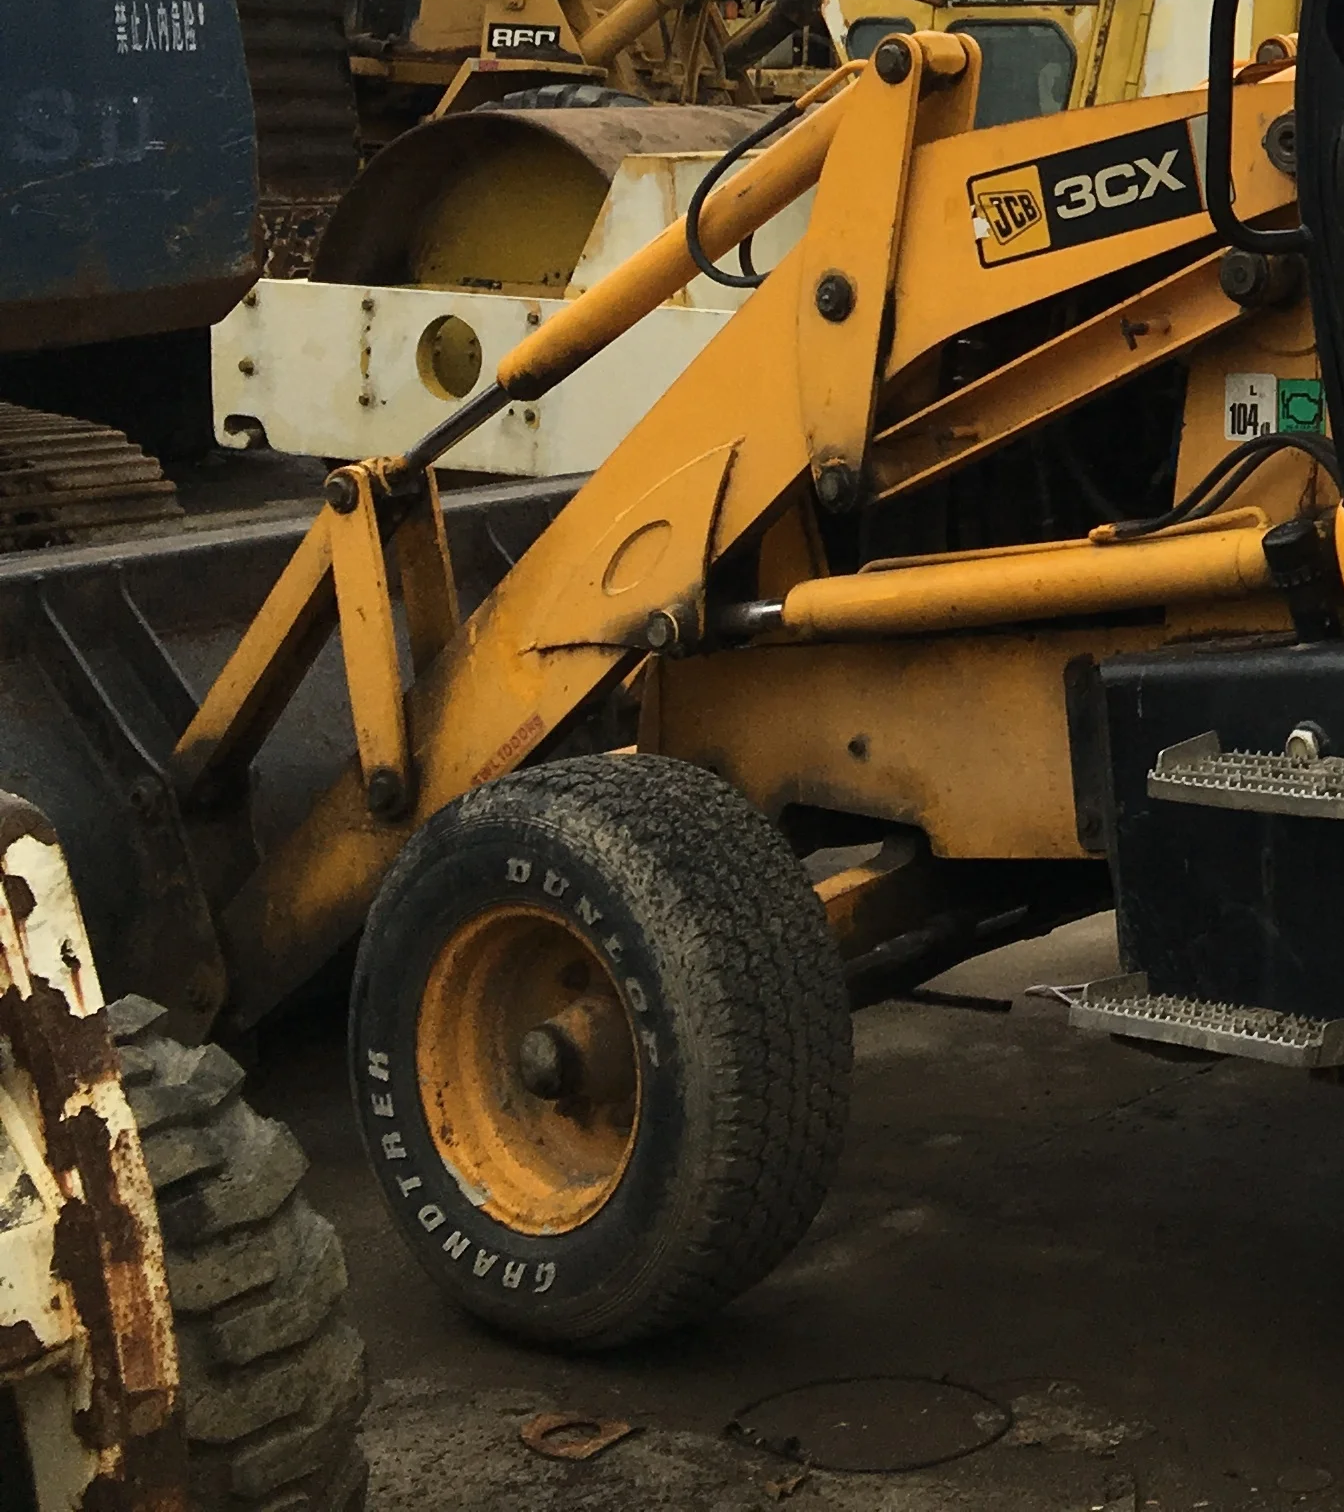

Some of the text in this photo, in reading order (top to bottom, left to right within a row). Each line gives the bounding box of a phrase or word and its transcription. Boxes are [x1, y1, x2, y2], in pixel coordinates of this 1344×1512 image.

[988, 149, 1186, 238] JCB 3CX
[1230, 403, 1258, 435] 104
[506, 857, 660, 1068] DUNLOP
[368, 1049, 556, 1293] GRANDTREK
